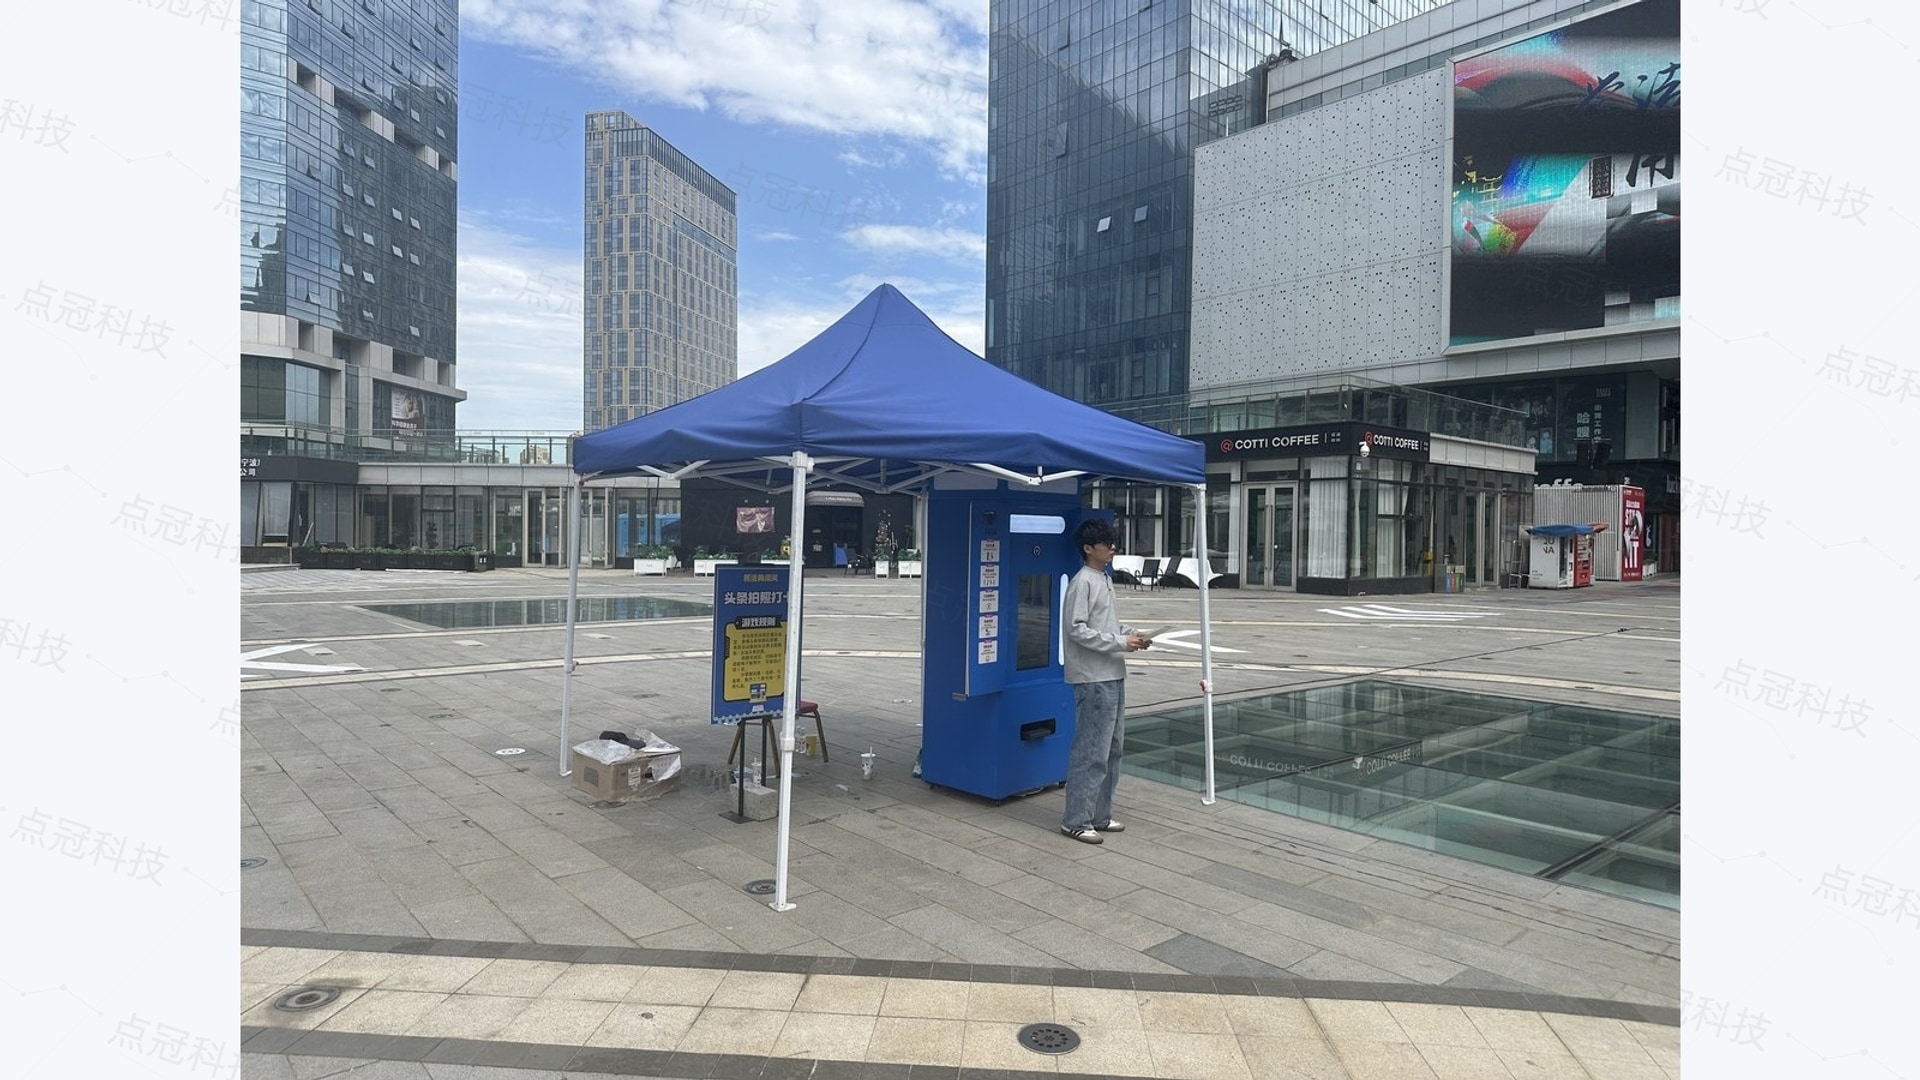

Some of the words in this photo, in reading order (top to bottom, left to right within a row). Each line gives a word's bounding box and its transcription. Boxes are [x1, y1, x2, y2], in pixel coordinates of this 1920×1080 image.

[1234, 438, 1268, 450] COTTI
[1271, 434, 1319, 447] COFFEE
[1373, 434, 1393, 447] COTTI
[1394, 437, 1419, 450] COFFEE
[741, 616, 776, 628] 游戏规则
